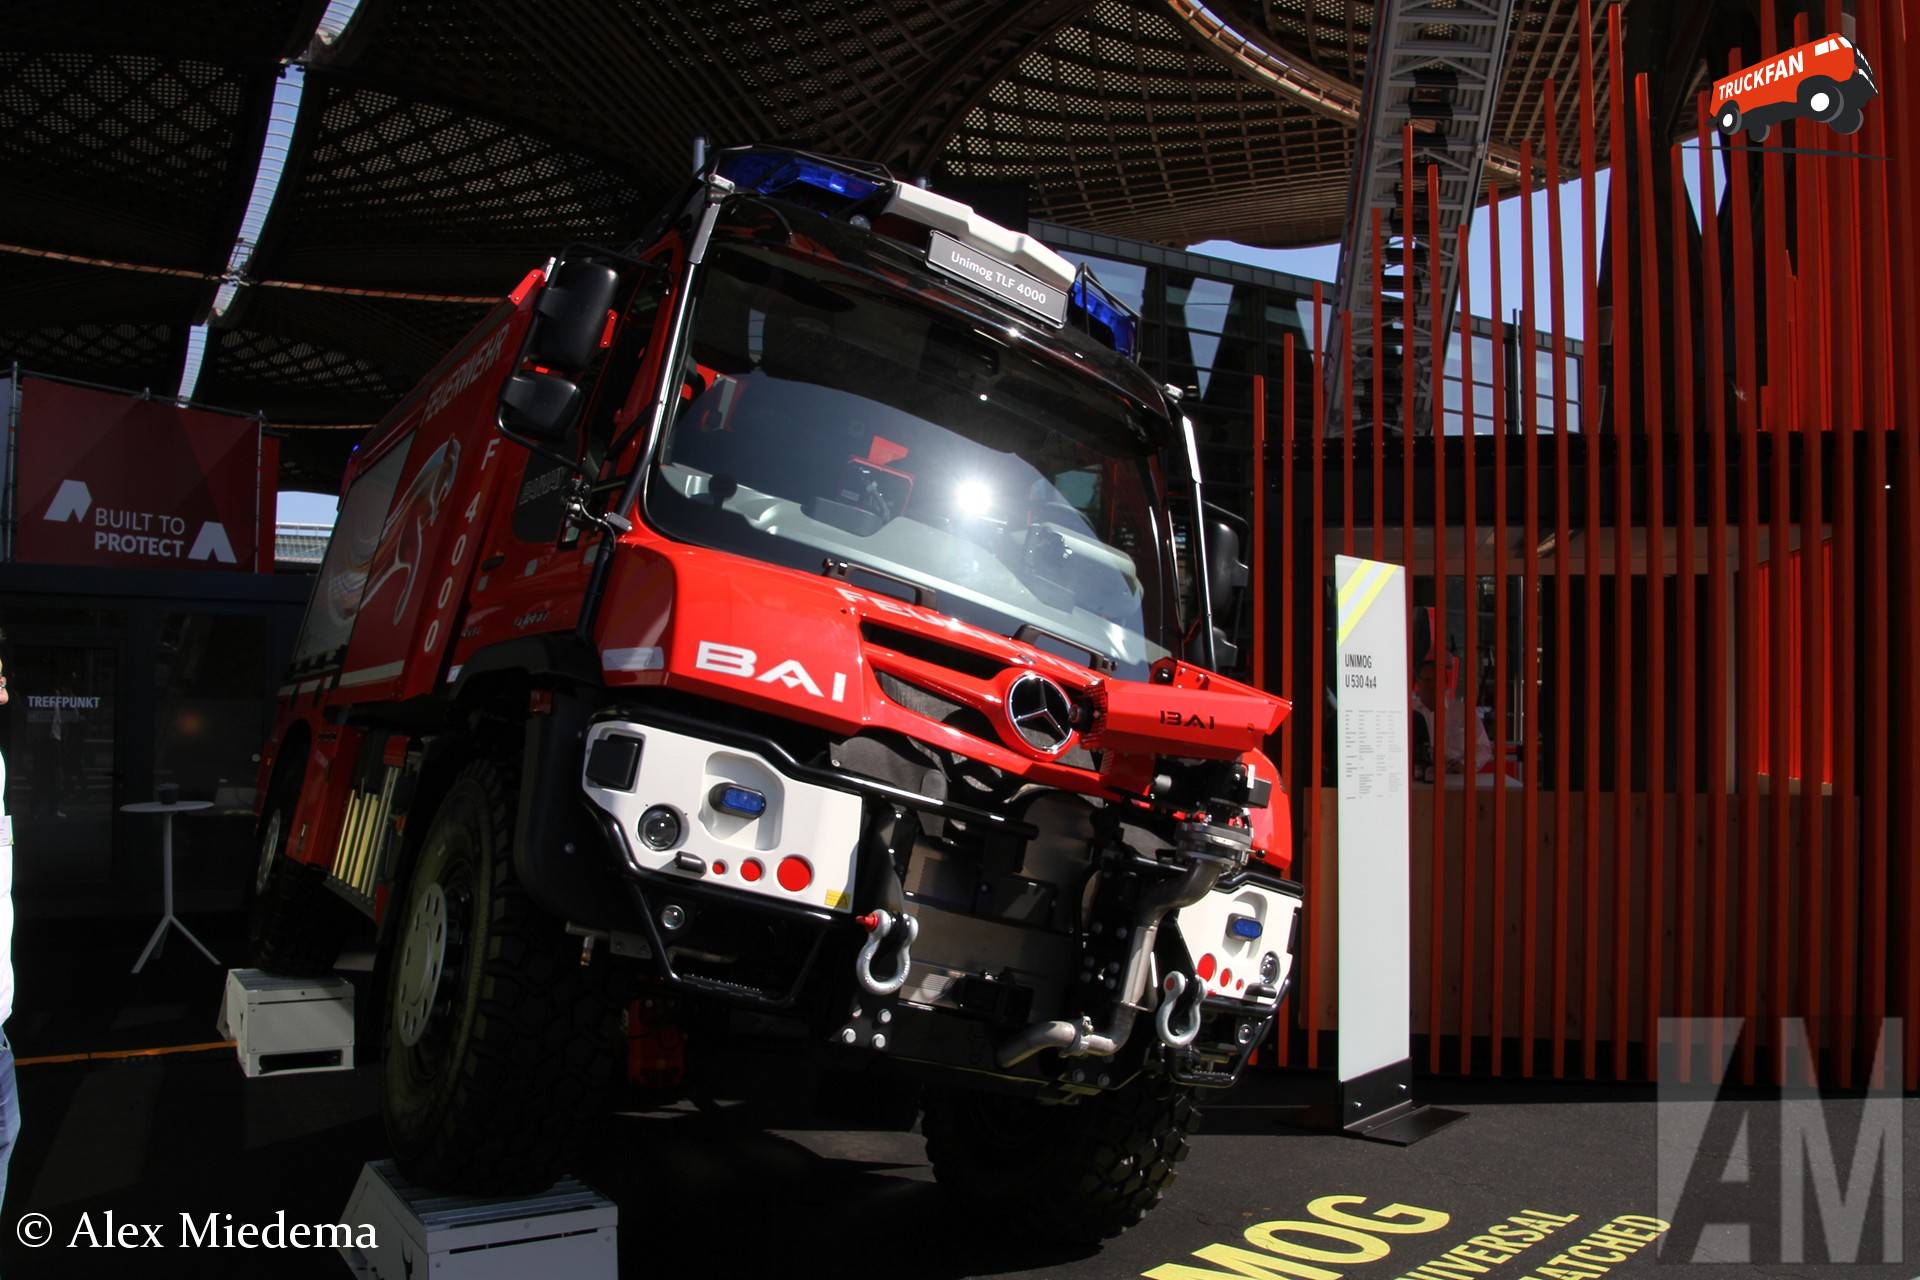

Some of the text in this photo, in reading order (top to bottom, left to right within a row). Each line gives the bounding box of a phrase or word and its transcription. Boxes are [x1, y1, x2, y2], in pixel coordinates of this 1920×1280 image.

[951, 251, 1047, 304] Unimog TLF 4000
[95, 507, 185, 535] BUILT TO
[94, 531, 184, 558] PROTECT
[696, 640, 847, 703] BAI
[1344, 653, 1372, 668] UNIMOG
[1351, 674, 1364, 688] 530
[27, 695, 101, 708] TREFFPUNKT
[1160, 710, 1215, 730] BAI
[1519, 1214, 1671, 1280] ATCHED
